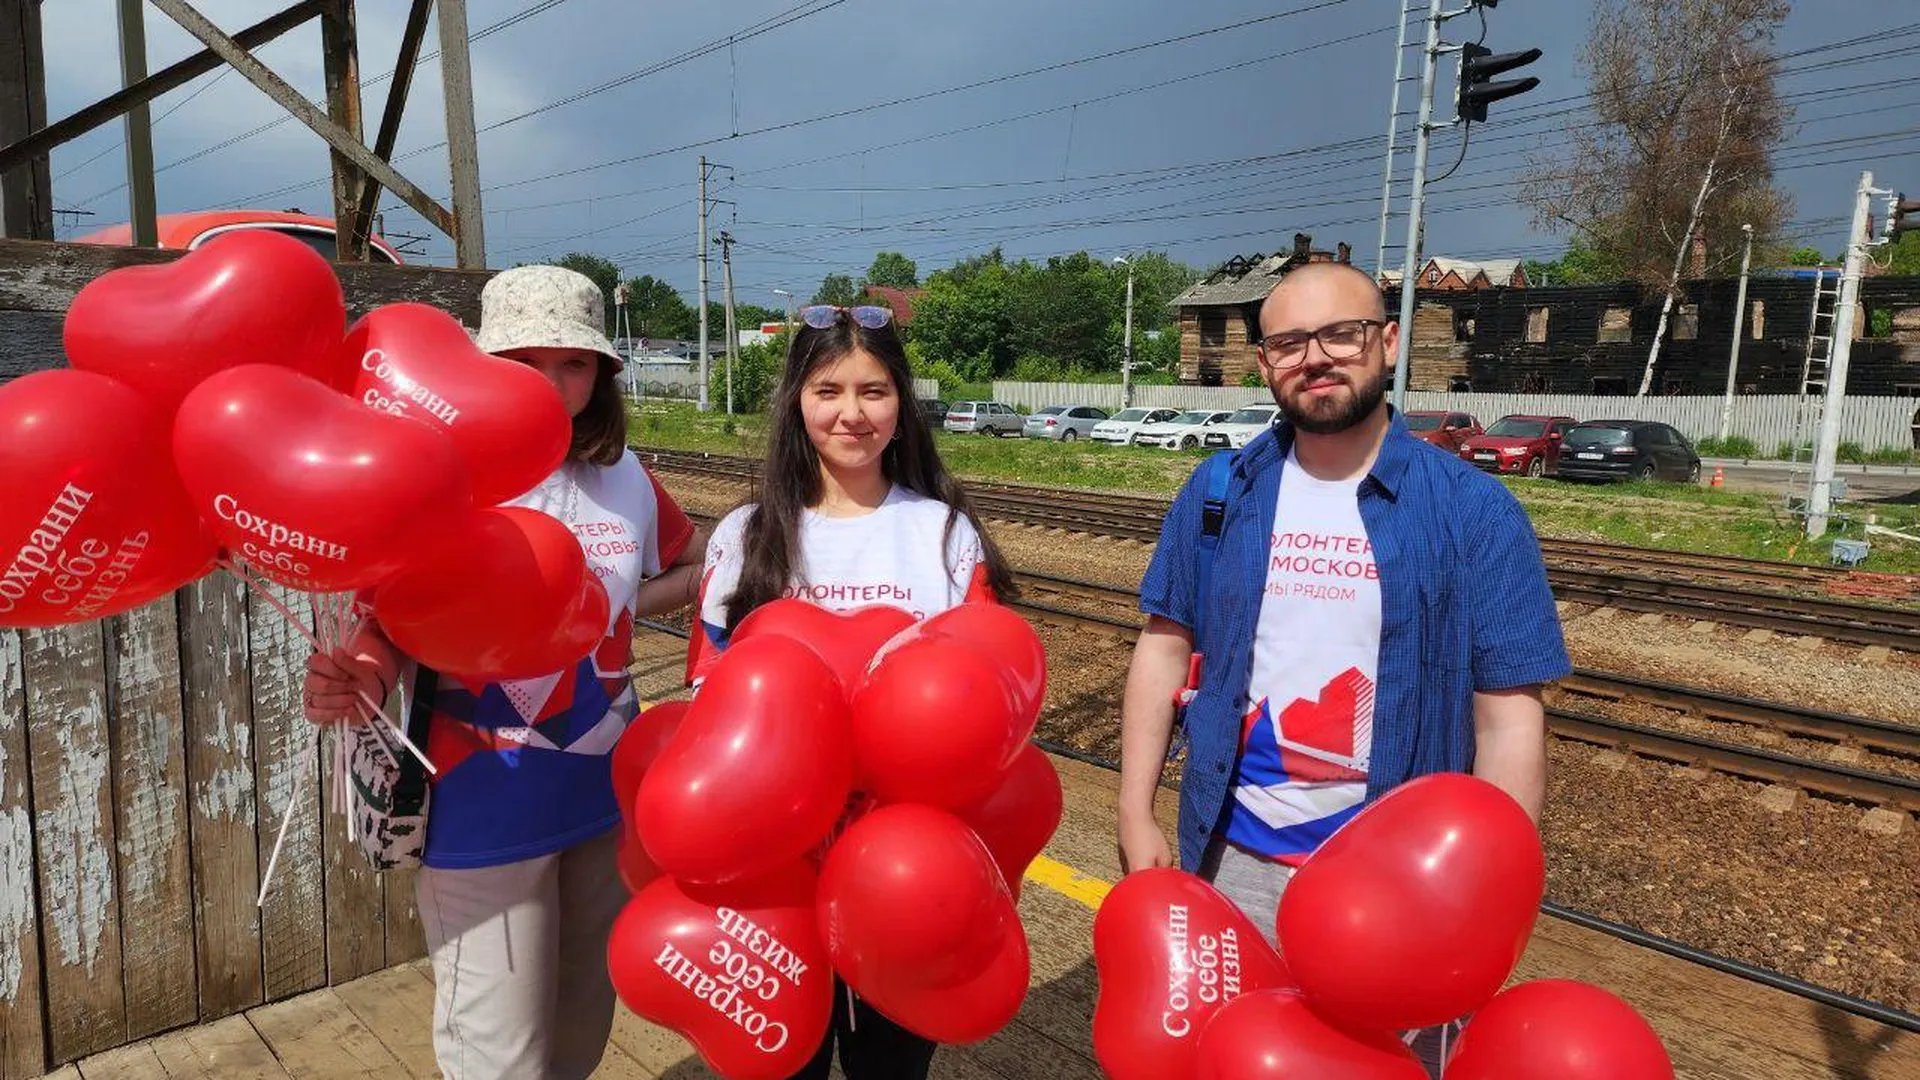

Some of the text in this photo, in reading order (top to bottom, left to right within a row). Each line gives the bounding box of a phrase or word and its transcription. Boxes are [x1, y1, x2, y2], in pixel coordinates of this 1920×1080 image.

[363, 388, 409, 416] себ
[213, 494, 348, 561] Сохрани
[243, 542, 311, 576] себе
[42, 538, 109, 605] себе
[64, 530, 149, 617] жизнь
[781, 584, 912, 601] ОЛОНТЕРЫ
[1271, 556, 1381, 580] МОСКОВ
[1293, 583, 1356, 600] РЯДОМ
[708, 941, 780, 1000] себе
[715, 906, 808, 986] жизнь
[1191, 934, 1219, 1003] себе
[654, 942, 789, 1053] Сохрани
